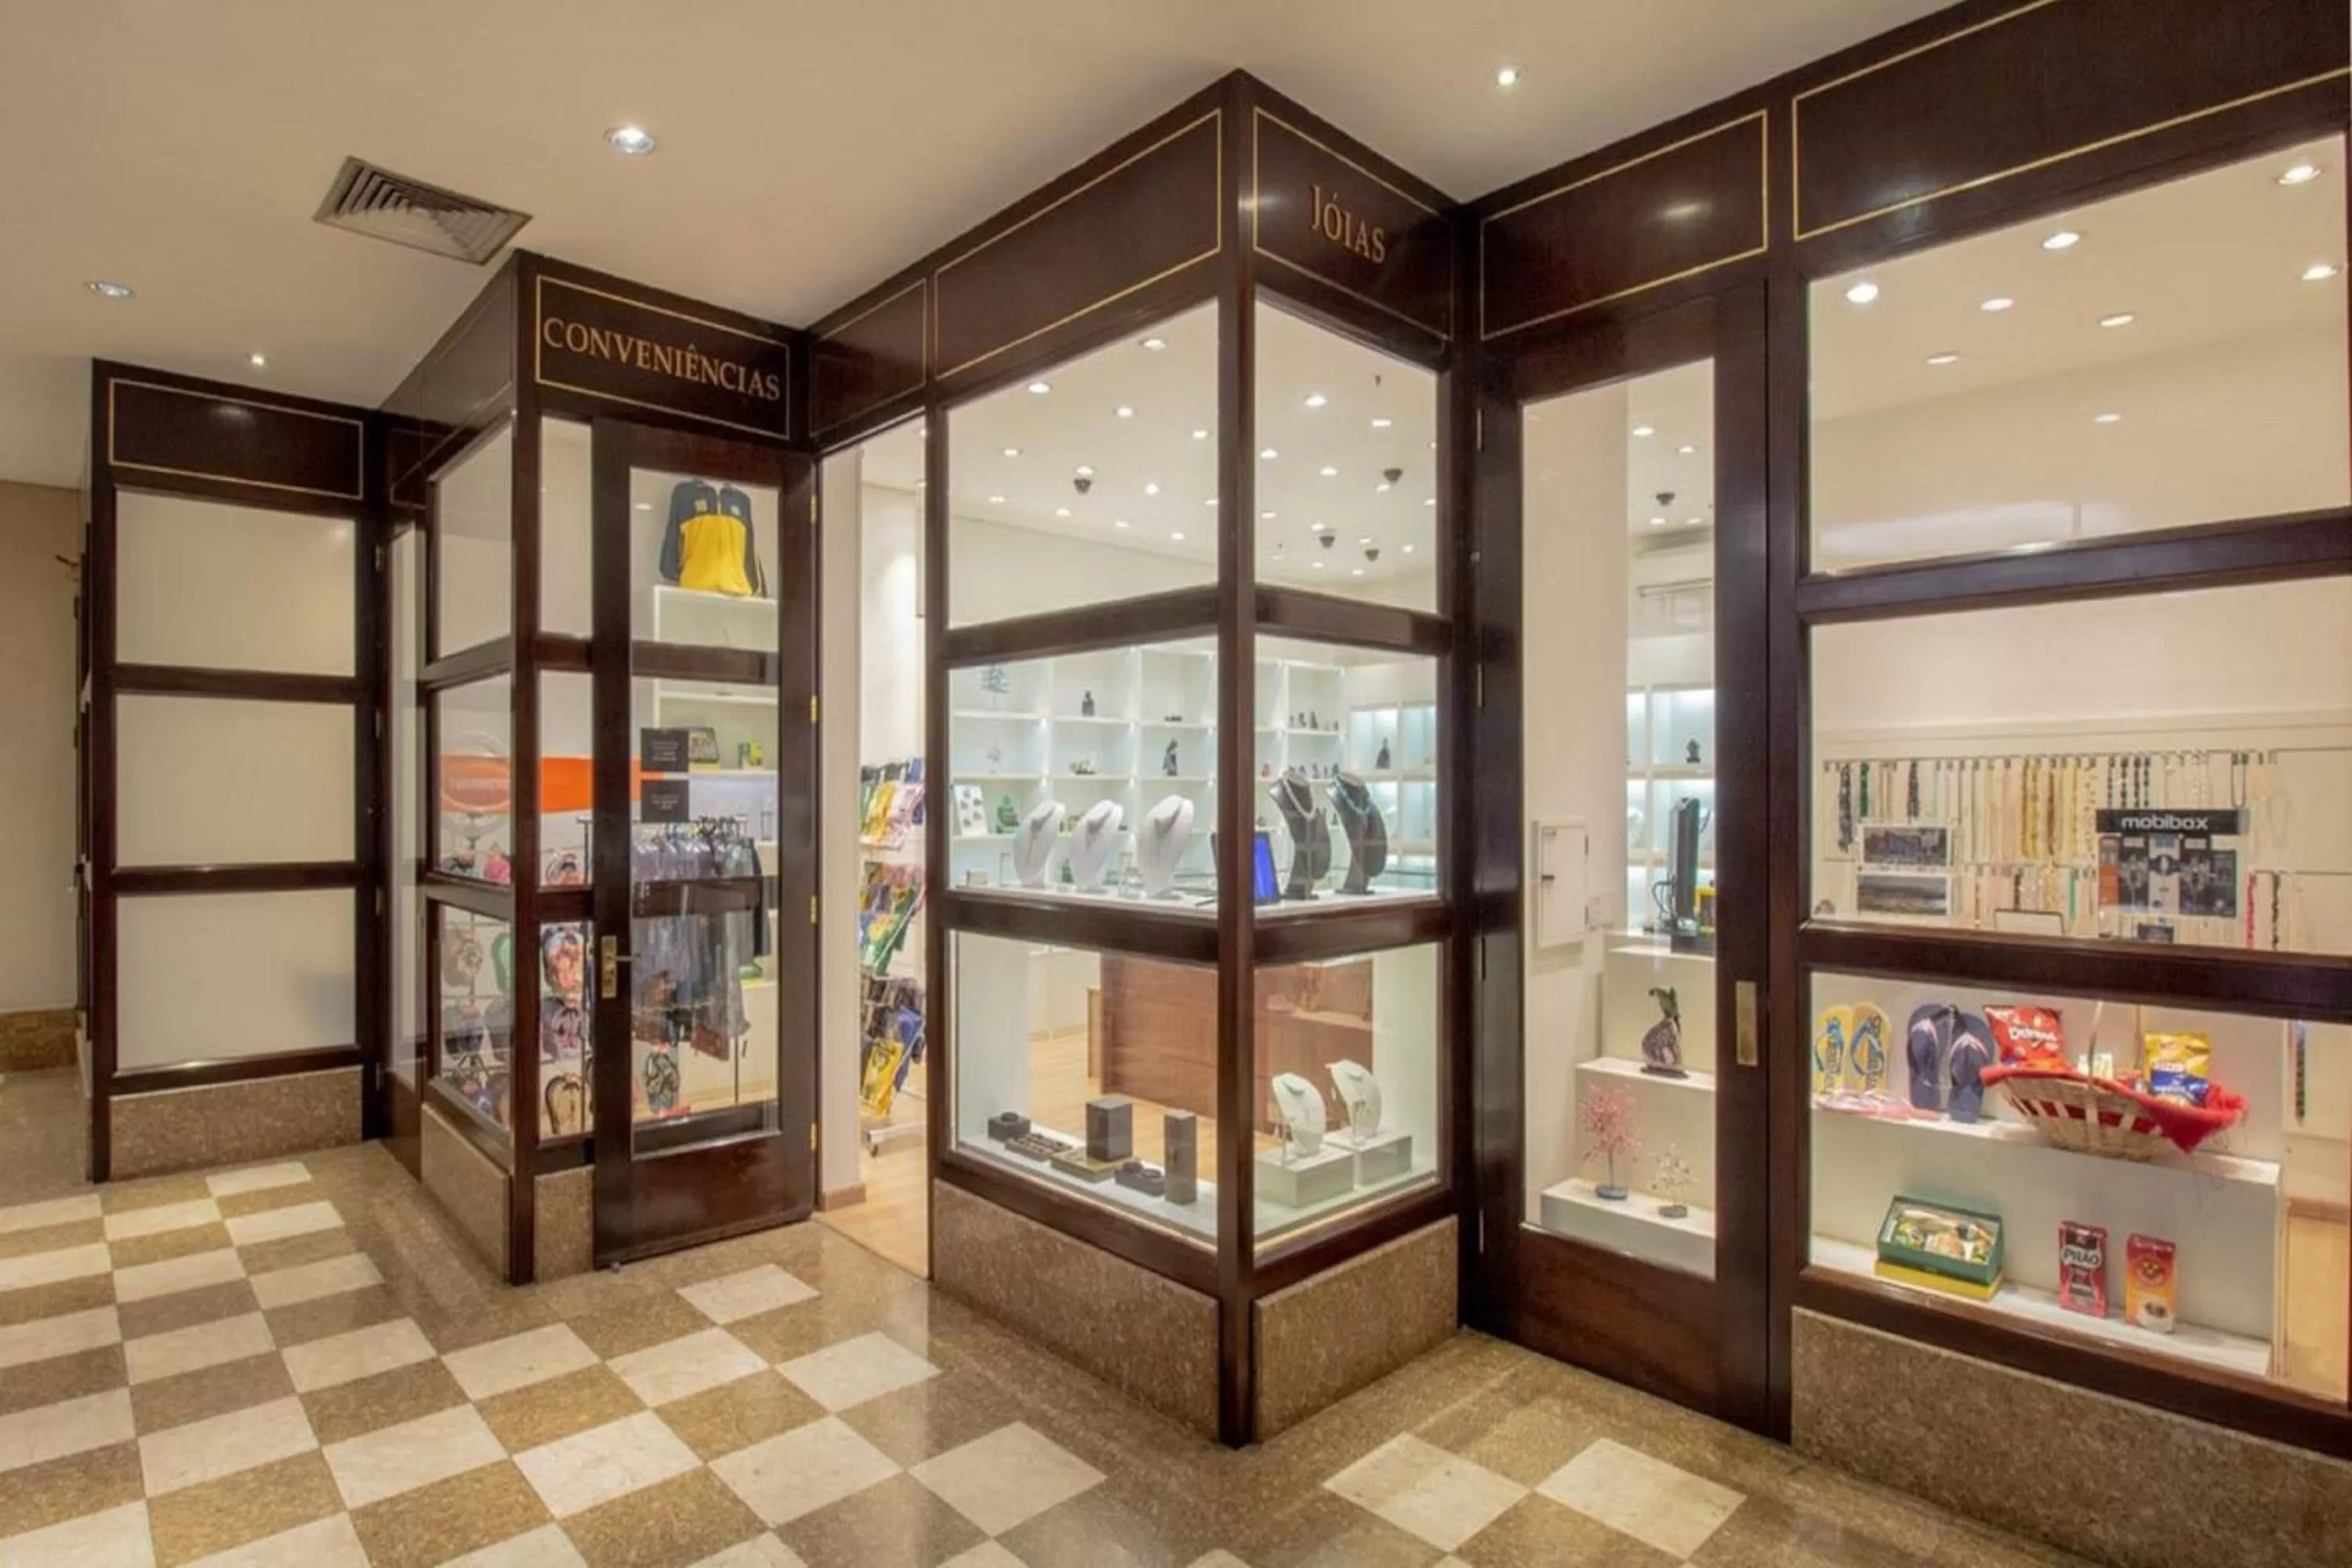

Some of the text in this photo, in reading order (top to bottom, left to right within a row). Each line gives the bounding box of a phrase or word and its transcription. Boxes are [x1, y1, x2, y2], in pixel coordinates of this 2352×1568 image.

[1312, 184, 1385, 264] JÓIAS
[543, 317, 780, 401] CONVENIÊNCIAS
[2122, 814, 2209, 831] mobibox
